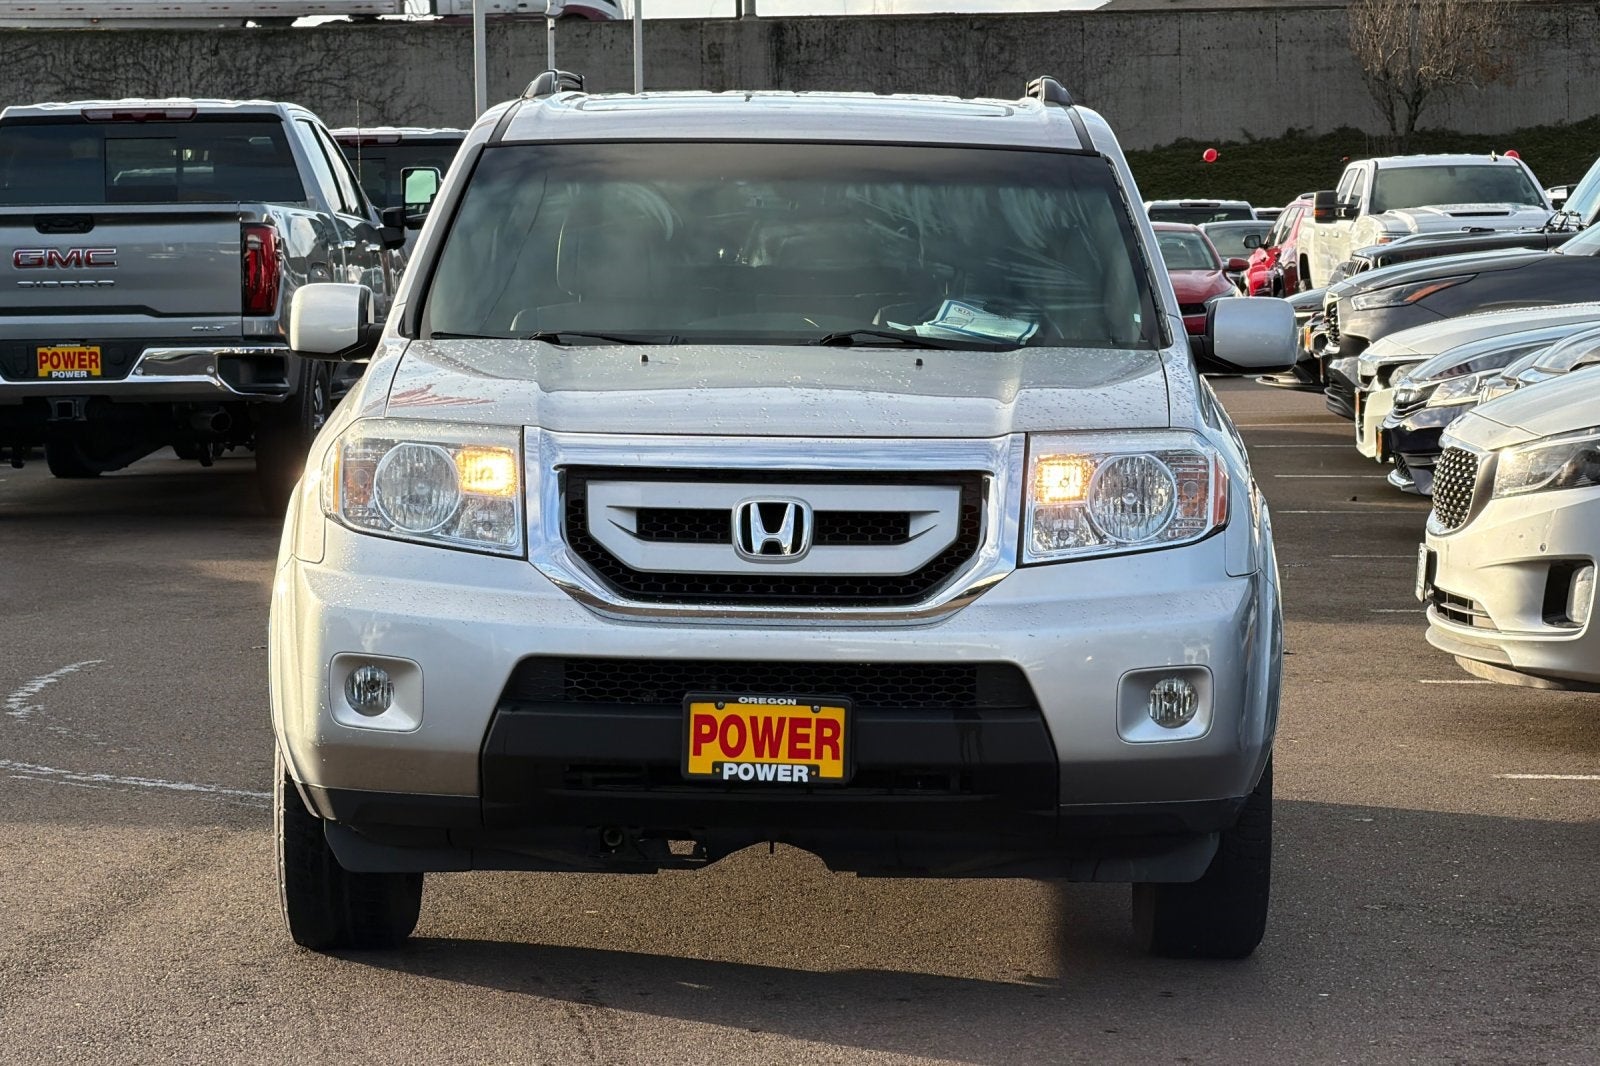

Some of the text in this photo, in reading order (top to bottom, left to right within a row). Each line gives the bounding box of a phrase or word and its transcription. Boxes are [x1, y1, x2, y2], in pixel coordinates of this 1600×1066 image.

[13, 249, 117, 269] GMC
[39, 351, 99, 369] POWER
[52, 370, 87, 378] POWER
[738, 696, 796, 706] OREGON
[693, 713, 841, 760] POWER
[722, 762, 808, 782] POWER
